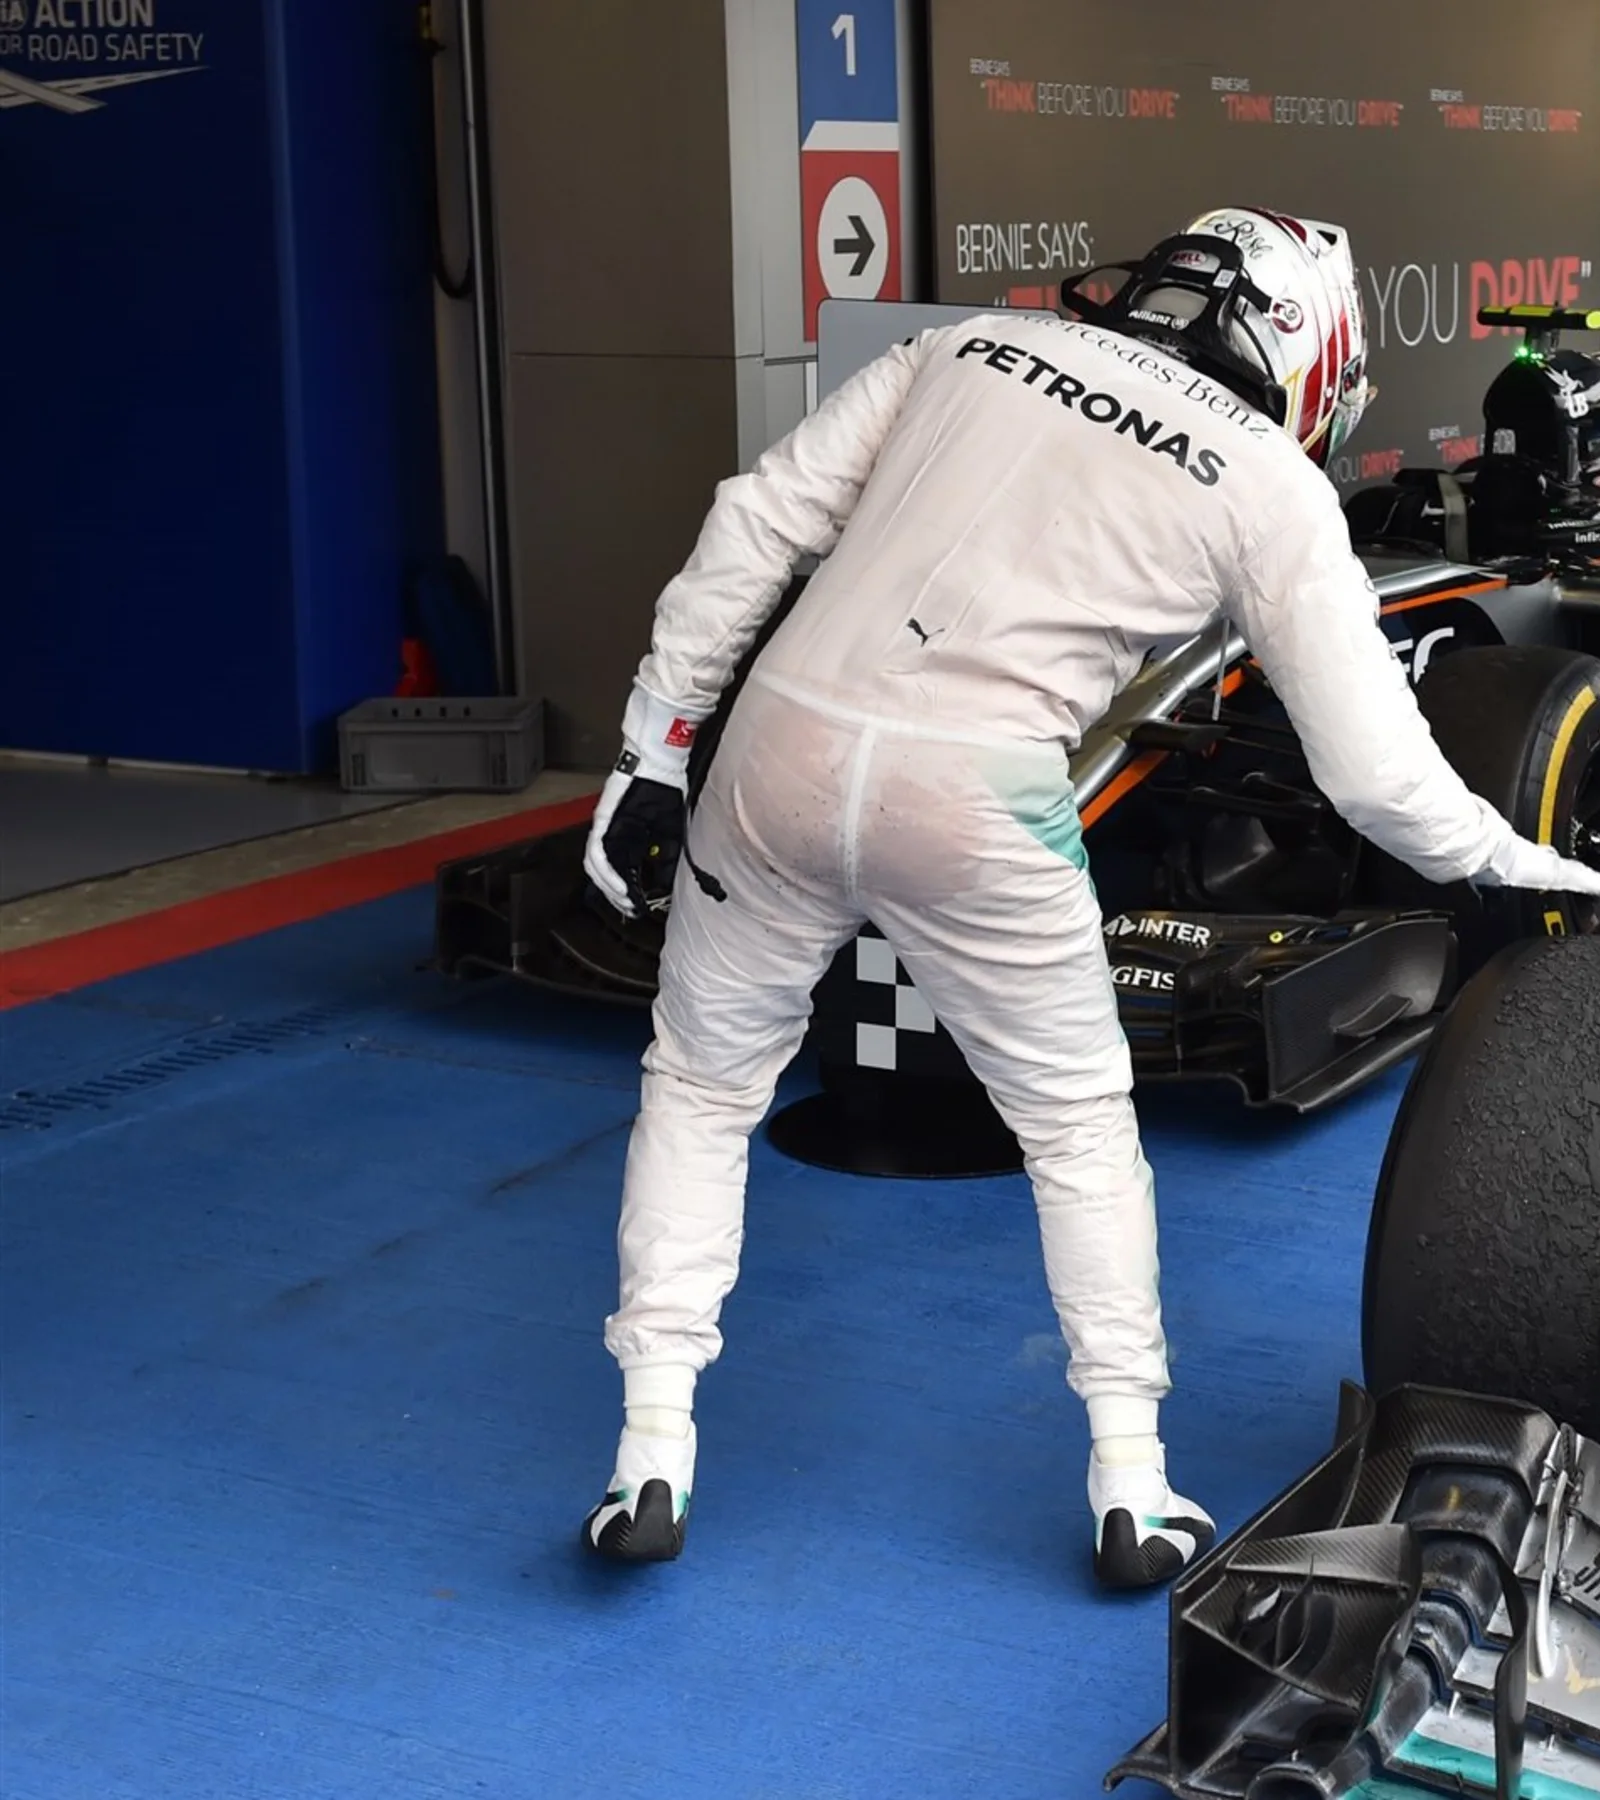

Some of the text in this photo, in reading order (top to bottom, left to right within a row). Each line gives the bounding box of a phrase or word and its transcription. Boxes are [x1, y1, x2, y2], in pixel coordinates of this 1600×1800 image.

[34, 0, 155, 28] ACTION
[0, 33, 205, 62] OR ROAD SAFETY
[831, 14, 856, 76] 1
[1037, 82, 1093, 116] BEFORE
[1094, 86, 1127, 117] YOU
[1274, 96, 1325, 125] BEFORE
[1327, 99, 1356, 126] YOU
[956, 221, 1096, 274] BERNIE SAYS:
[1128, 310, 1171, 326] Allianz
[1368, 262, 1460, 350] YOU
[954, 337, 1228, 487] PETRONAS
[1137, 917, 1211, 946] INTER
[1099, 964, 1175, 990] GFIS
